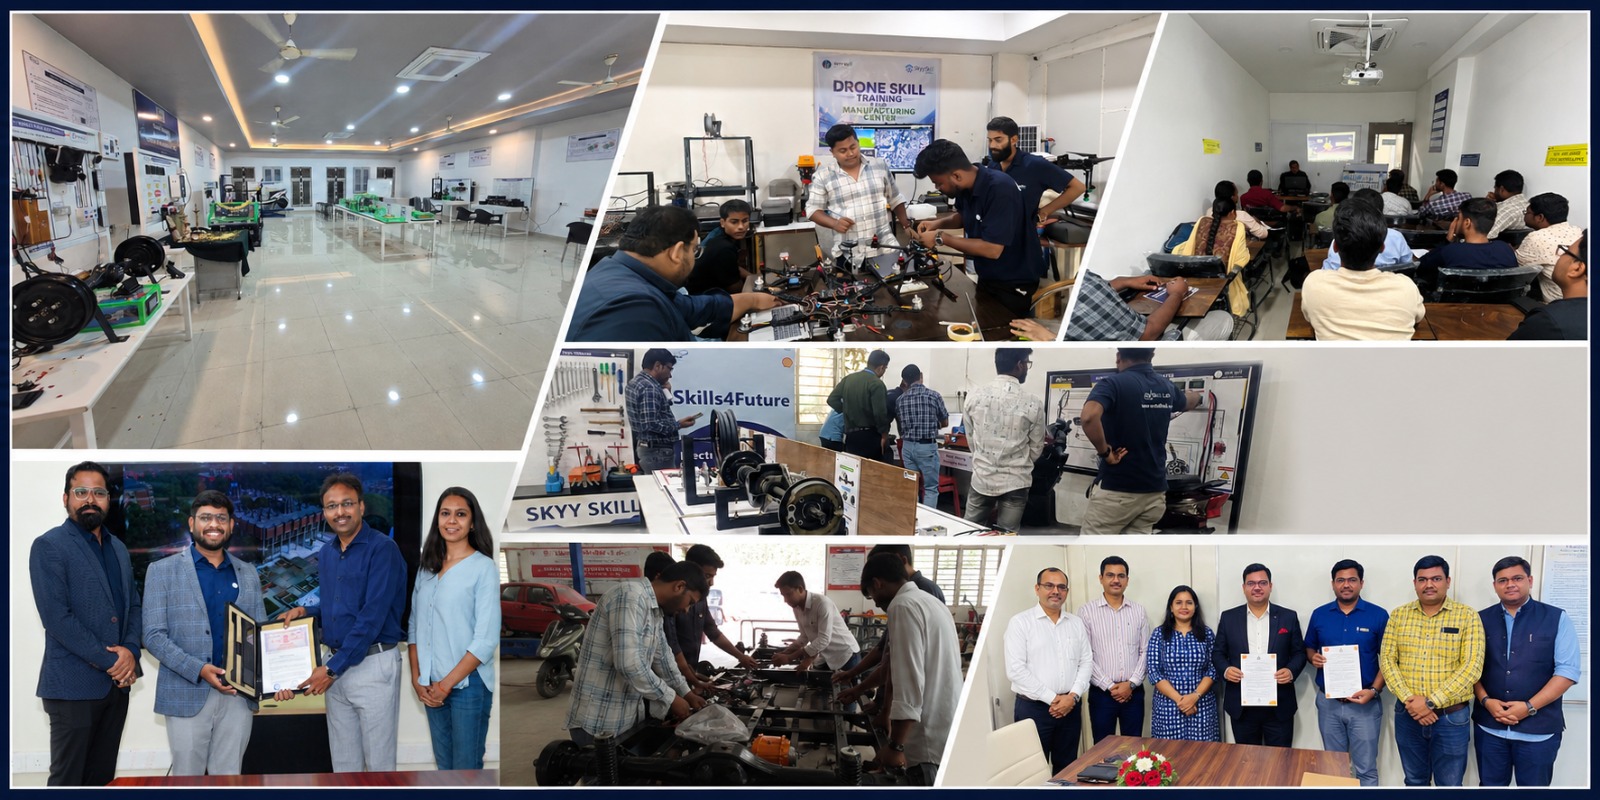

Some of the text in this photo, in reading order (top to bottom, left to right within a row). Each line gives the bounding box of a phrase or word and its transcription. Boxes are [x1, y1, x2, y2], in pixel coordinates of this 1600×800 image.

[833, 80, 926, 96] DRONE SKILL
[856, 94, 902, 103] TRAINING
[673, 389, 790, 407] Skills4Future
[526, 499, 640, 522] SKYY SKILL
